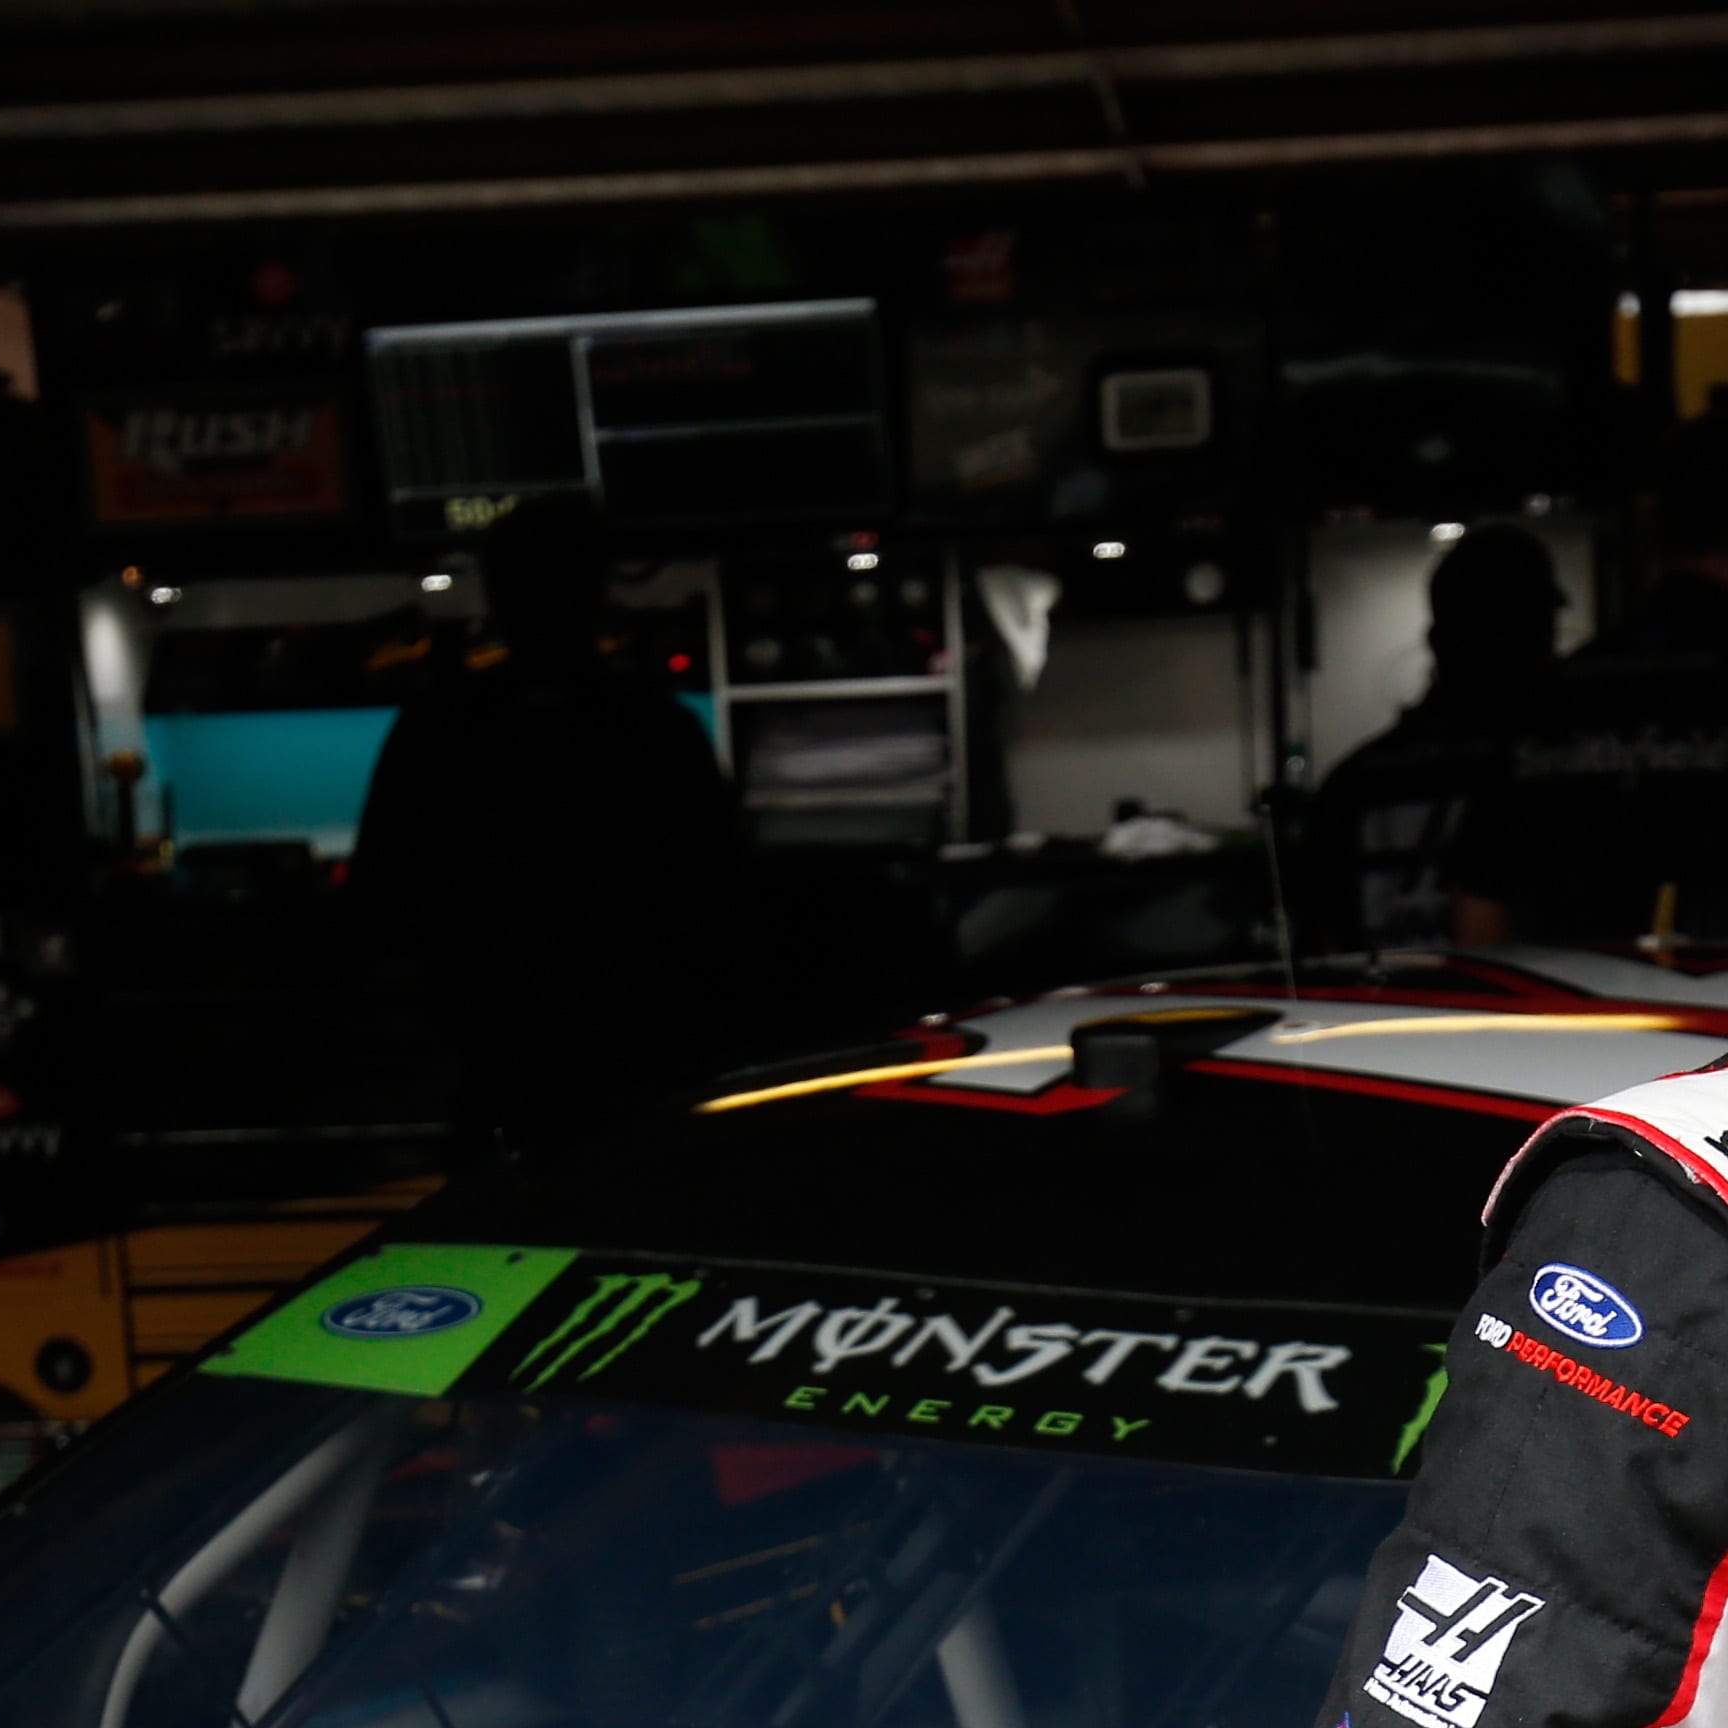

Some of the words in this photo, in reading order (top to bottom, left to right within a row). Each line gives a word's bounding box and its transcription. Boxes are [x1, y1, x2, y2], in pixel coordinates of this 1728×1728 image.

[1539, 1274, 1619, 1337] Ford
[1474, 1312, 1513, 1349] FORD
[1506, 1329, 1692, 1438] PERFORMANCE
[783, 1383, 1152, 1441] ENERGY
[1377, 1652, 1491, 1713] HAAS
